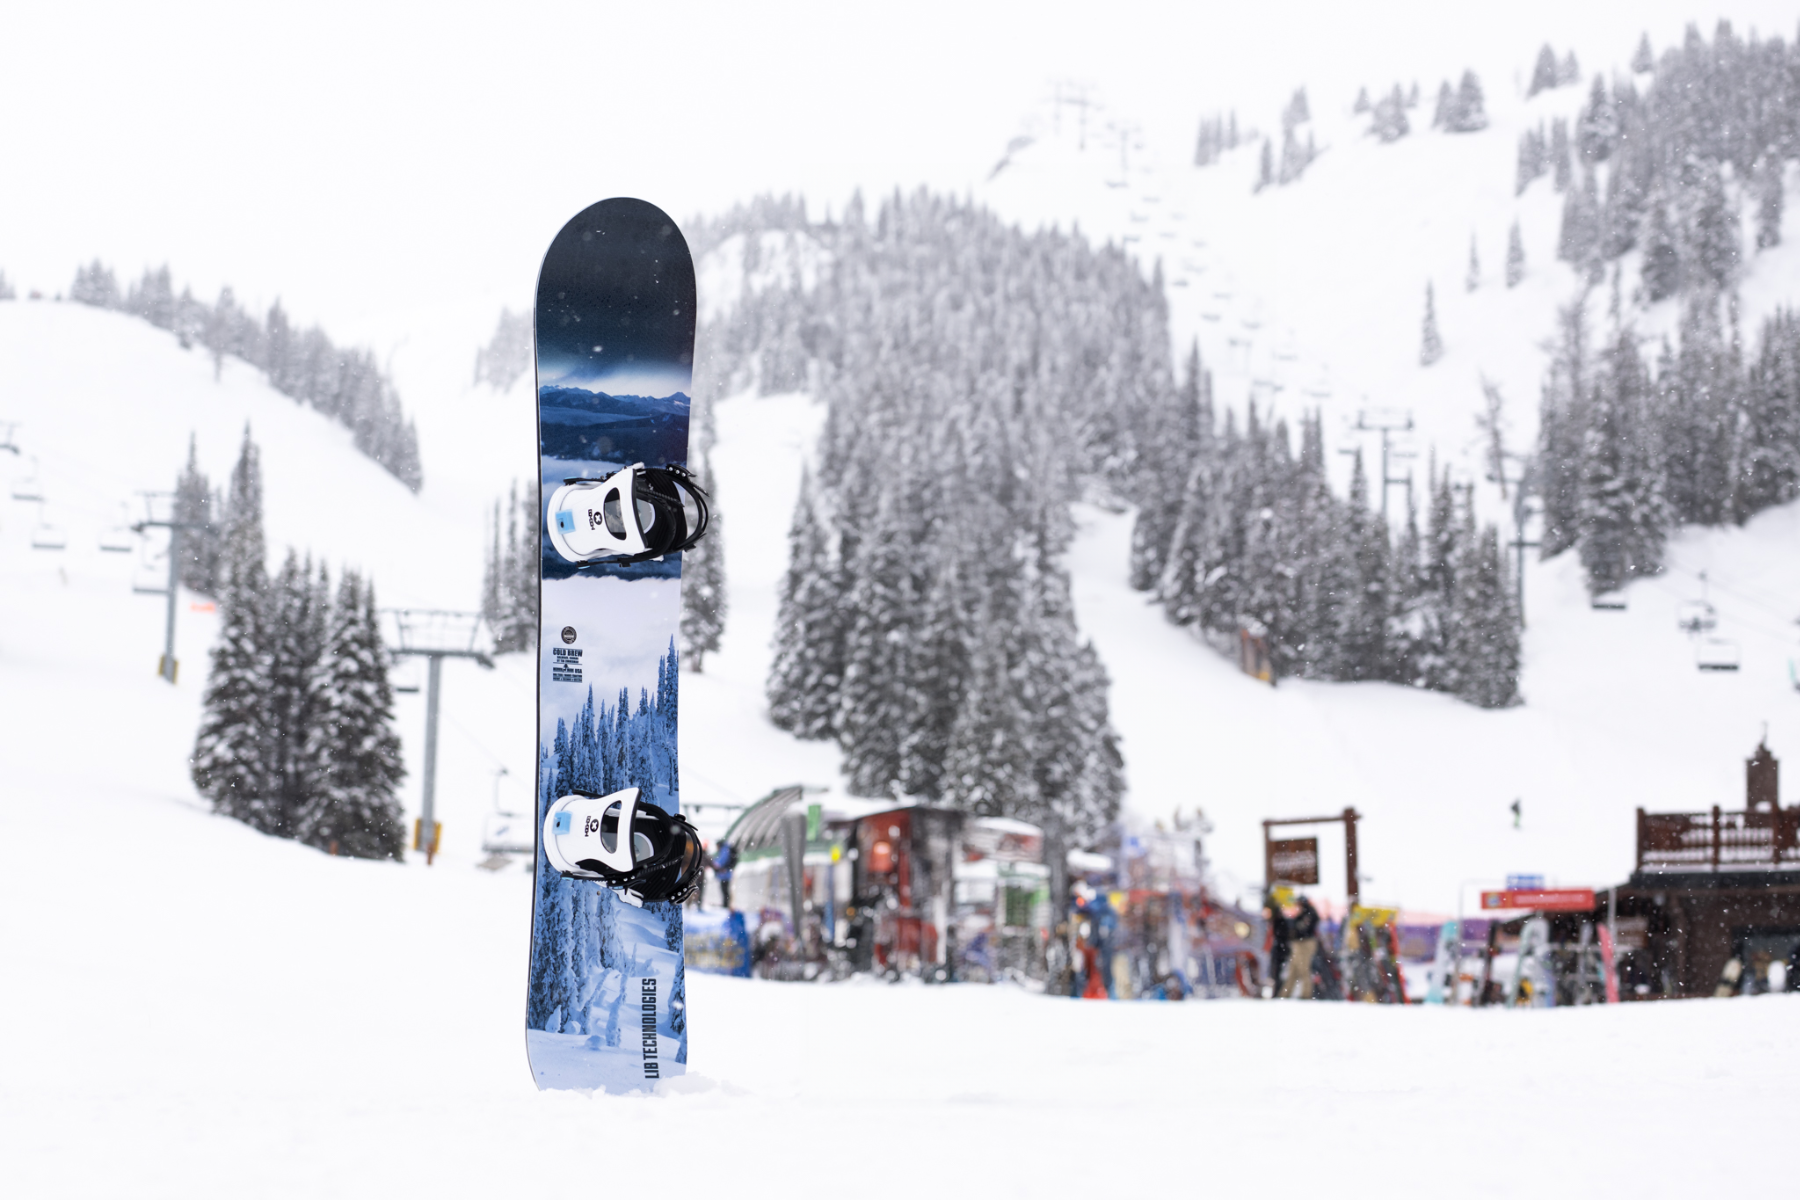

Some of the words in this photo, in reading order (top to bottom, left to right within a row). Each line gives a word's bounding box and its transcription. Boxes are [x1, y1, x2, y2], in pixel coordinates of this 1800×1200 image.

[568, 649, 582, 657] BREW
[642, 978, 658, 1060] TECHNOLOGIES
[644, 1062, 659, 1079] LIB
